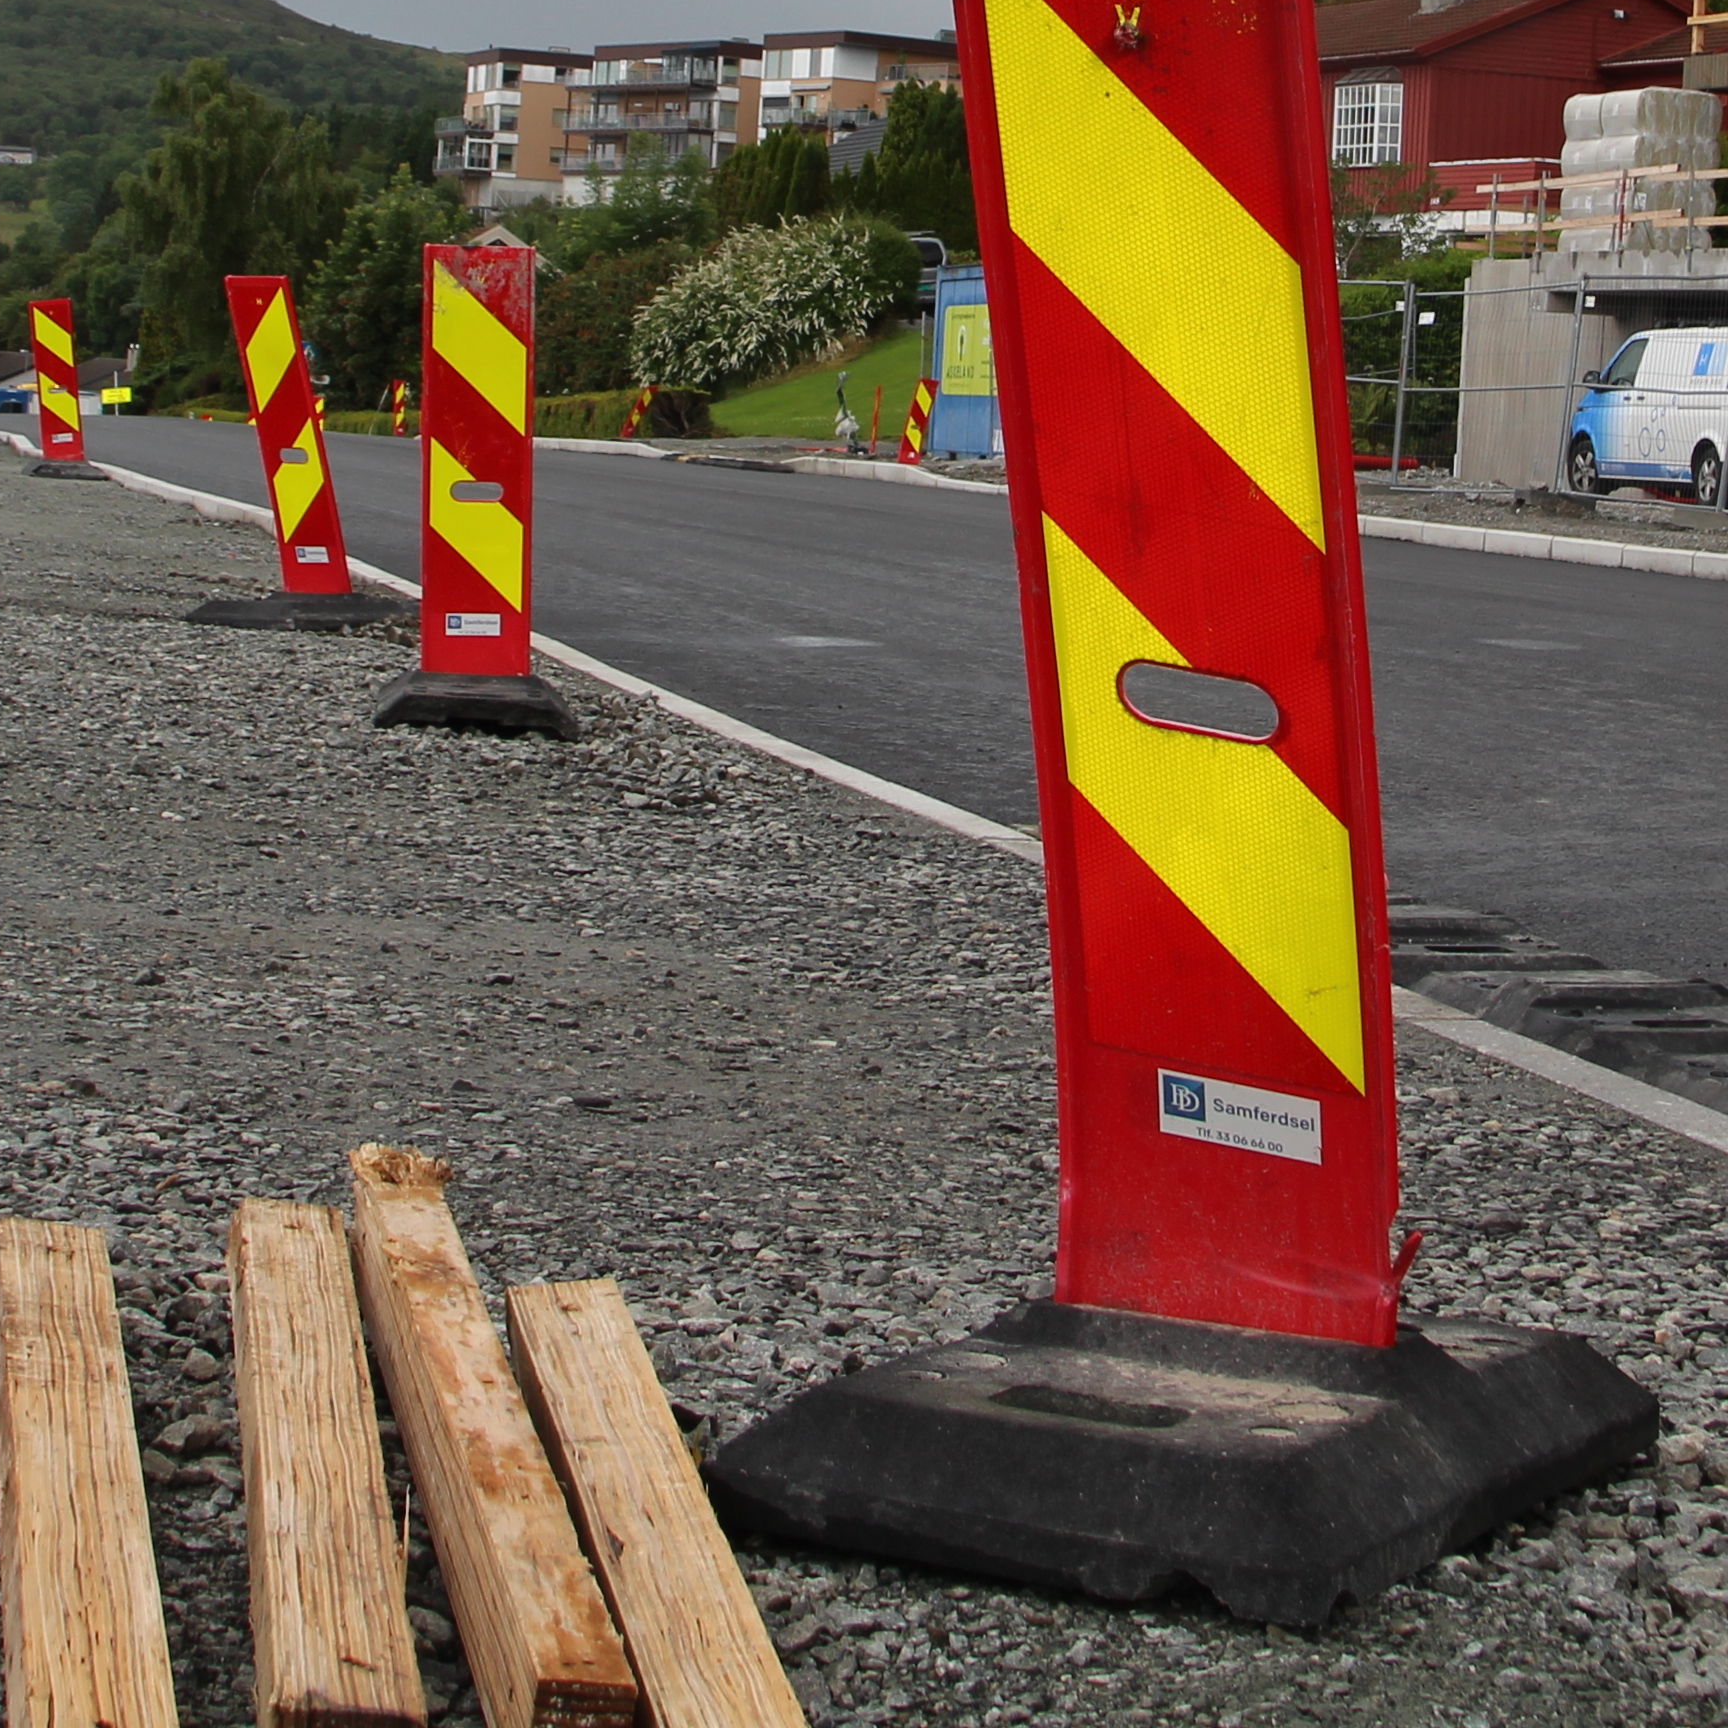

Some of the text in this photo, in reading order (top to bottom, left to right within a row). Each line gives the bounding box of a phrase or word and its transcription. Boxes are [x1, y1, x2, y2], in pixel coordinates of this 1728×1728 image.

[1213, 1098, 1315, 1132] Samferdsel
[1196, 1126, 1283, 1154] Tlf. 33 06 66 00
